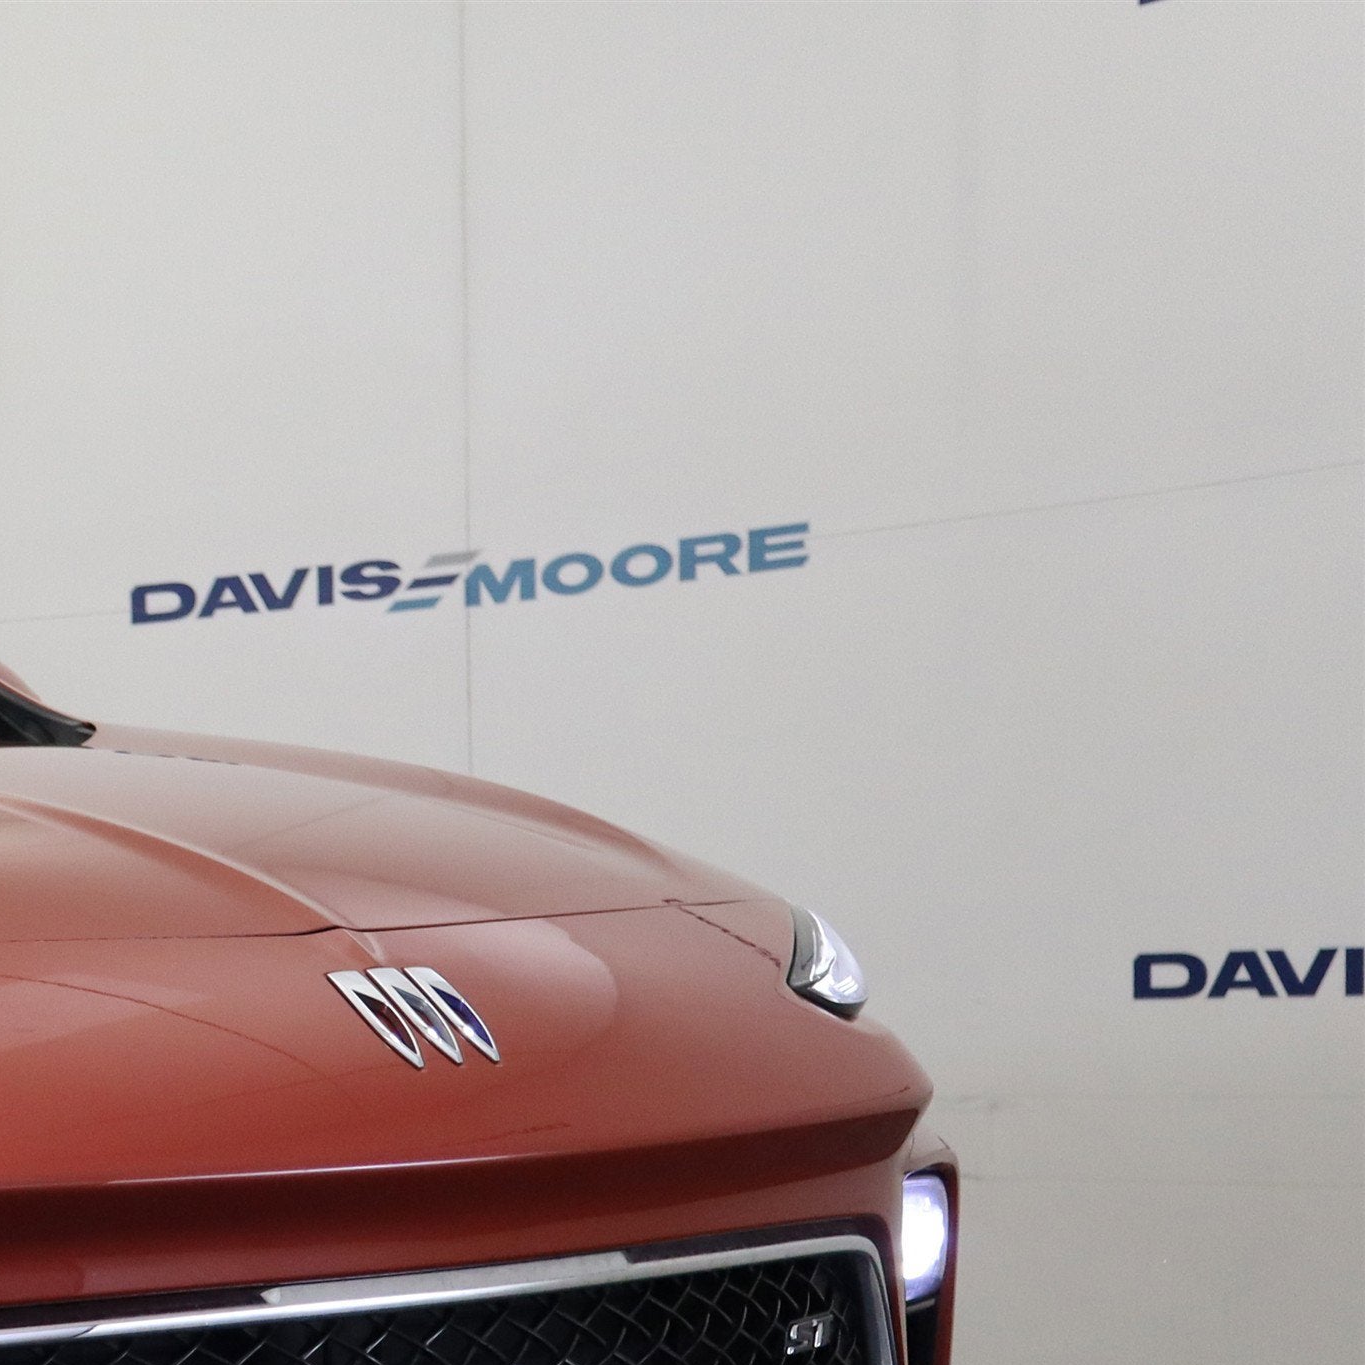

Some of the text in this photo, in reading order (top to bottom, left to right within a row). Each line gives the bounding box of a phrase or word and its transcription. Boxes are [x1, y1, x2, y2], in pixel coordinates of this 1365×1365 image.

[129, 521, 811, 626] DAVIS MOORE
[1132, 947, 1365, 1001] DAVI
